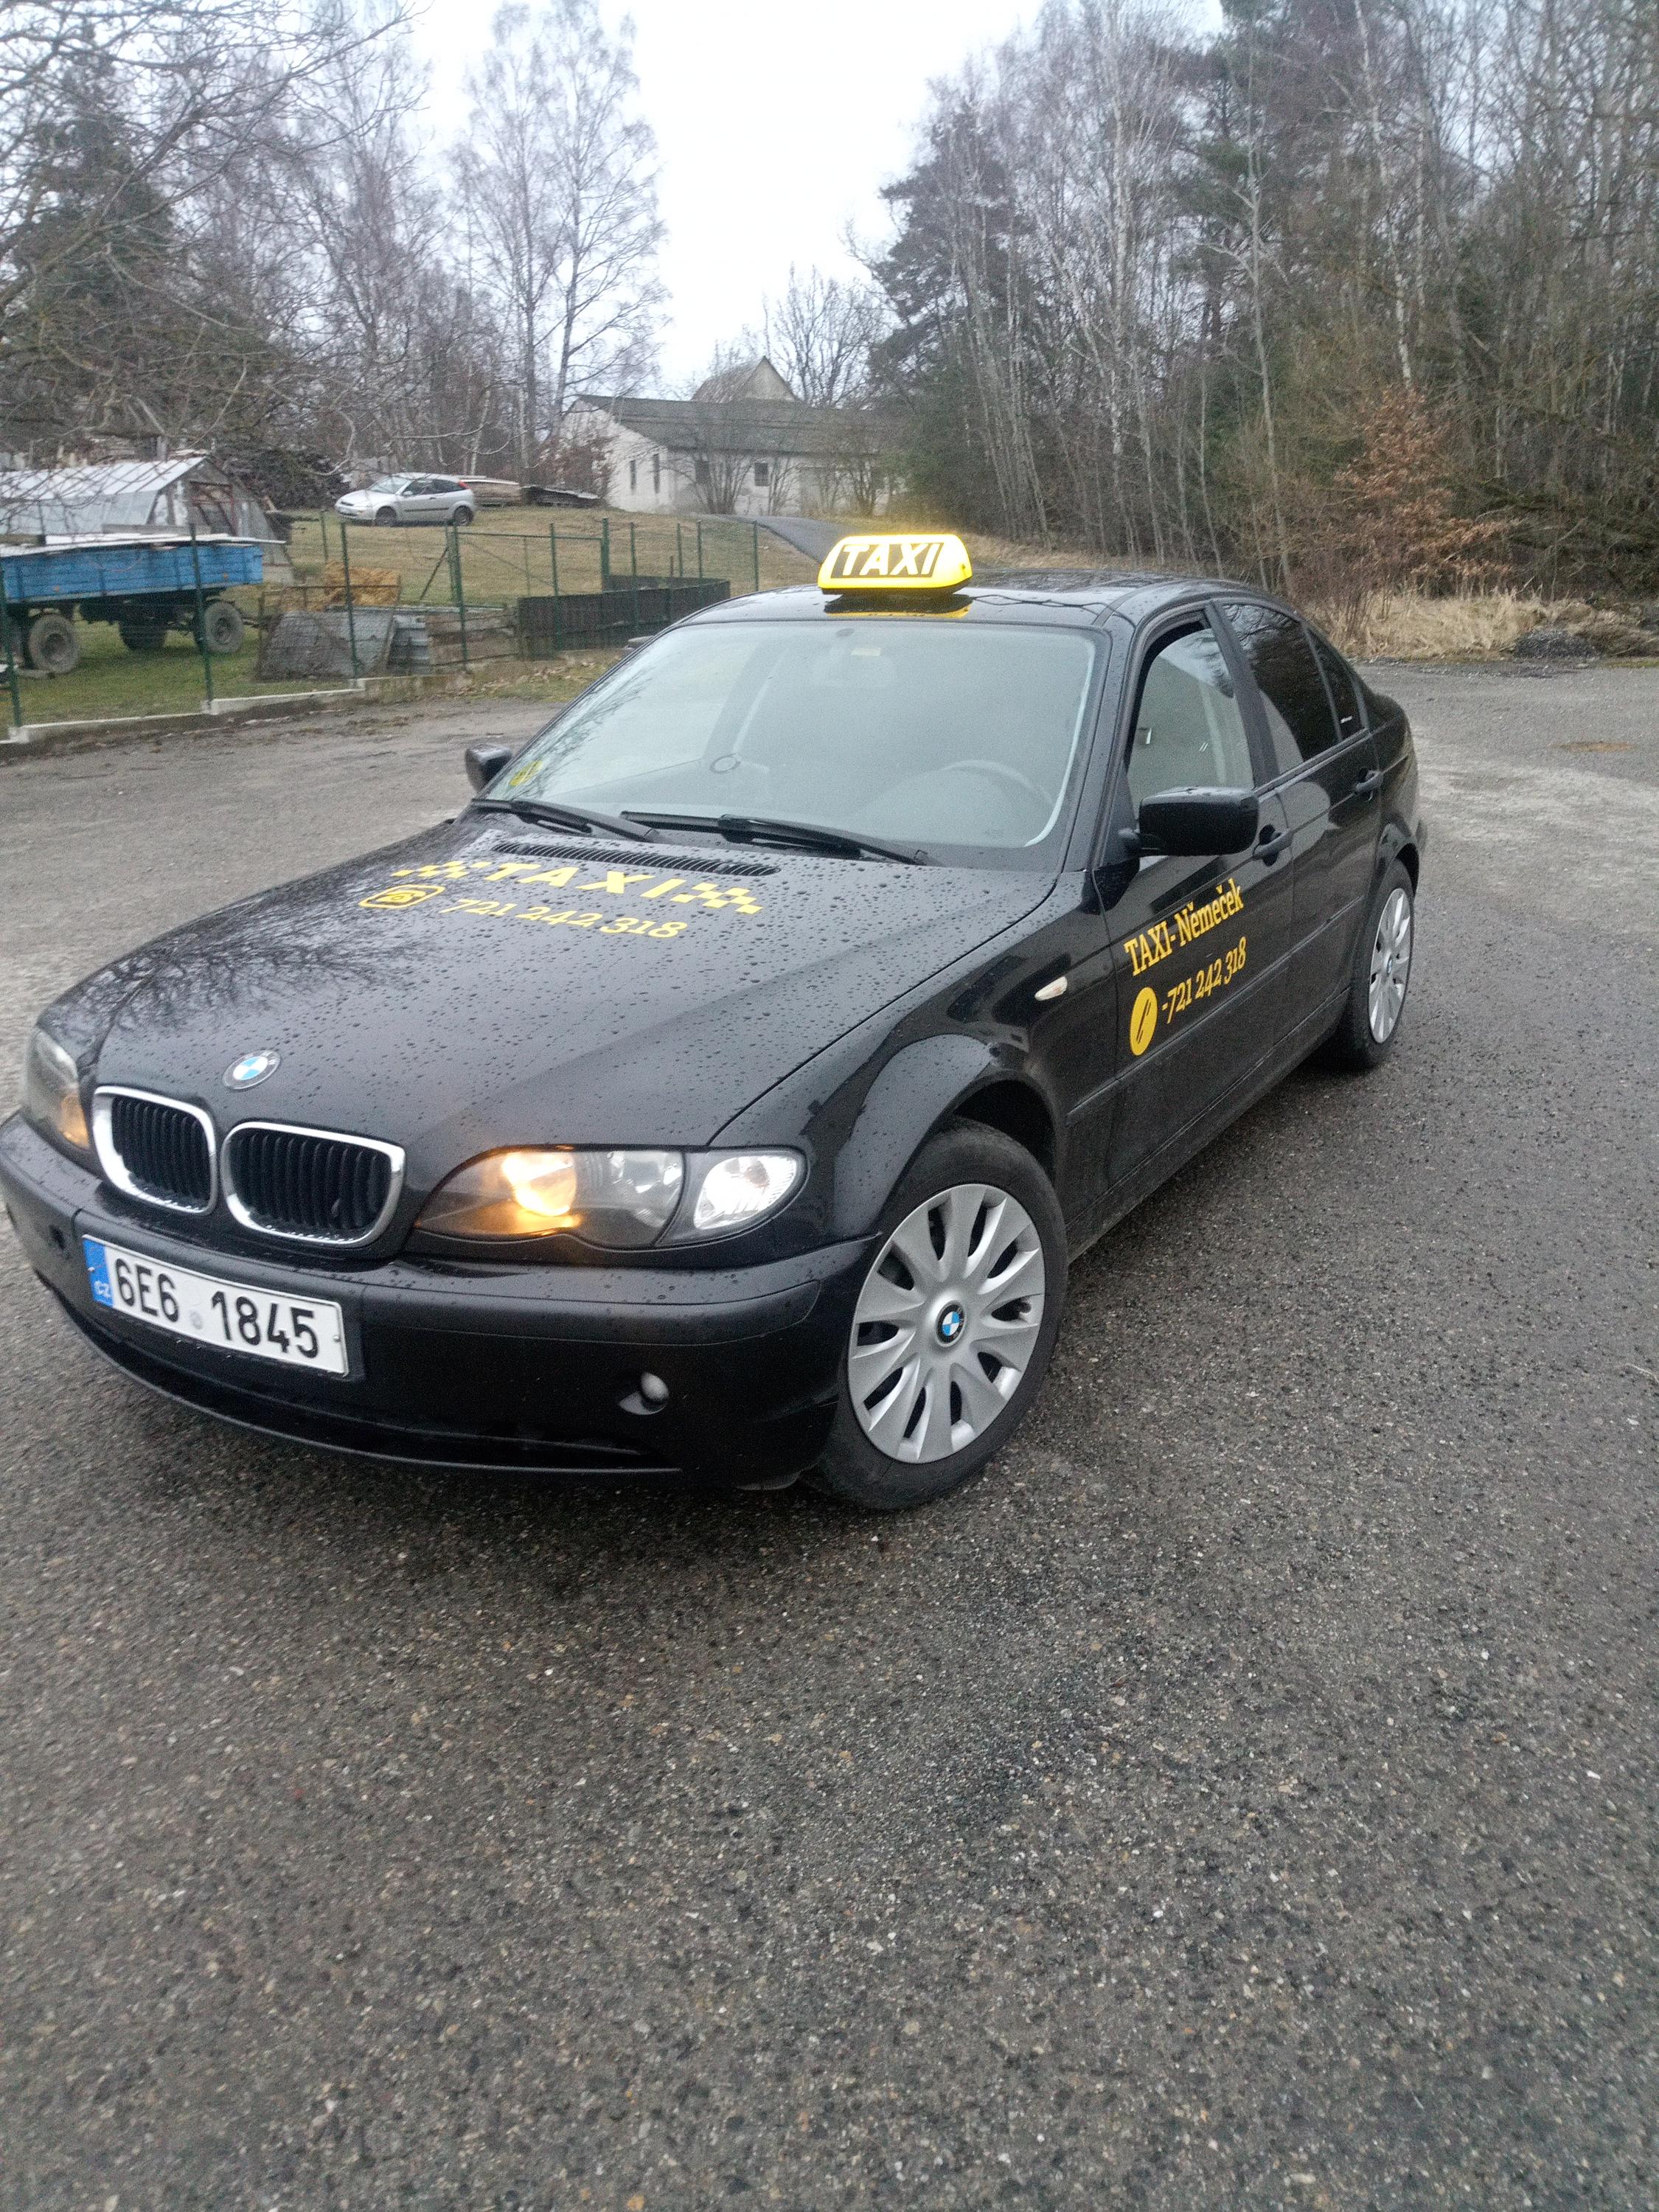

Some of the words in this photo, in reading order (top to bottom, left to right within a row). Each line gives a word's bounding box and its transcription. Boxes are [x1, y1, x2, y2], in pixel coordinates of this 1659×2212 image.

[842, 543, 940, 576] TAXI
[484, 863, 686, 898] TAXI
[439, 898, 518, 916] 721
[515, 906, 603, 928] 242
[599, 917, 688, 938] 318
[1194, 959, 1222, 998] 242
[1223, 936, 1247, 985] 318
[115, 1258, 180, 1323] 6E6
[211, 1290, 319, 1359] 1845
